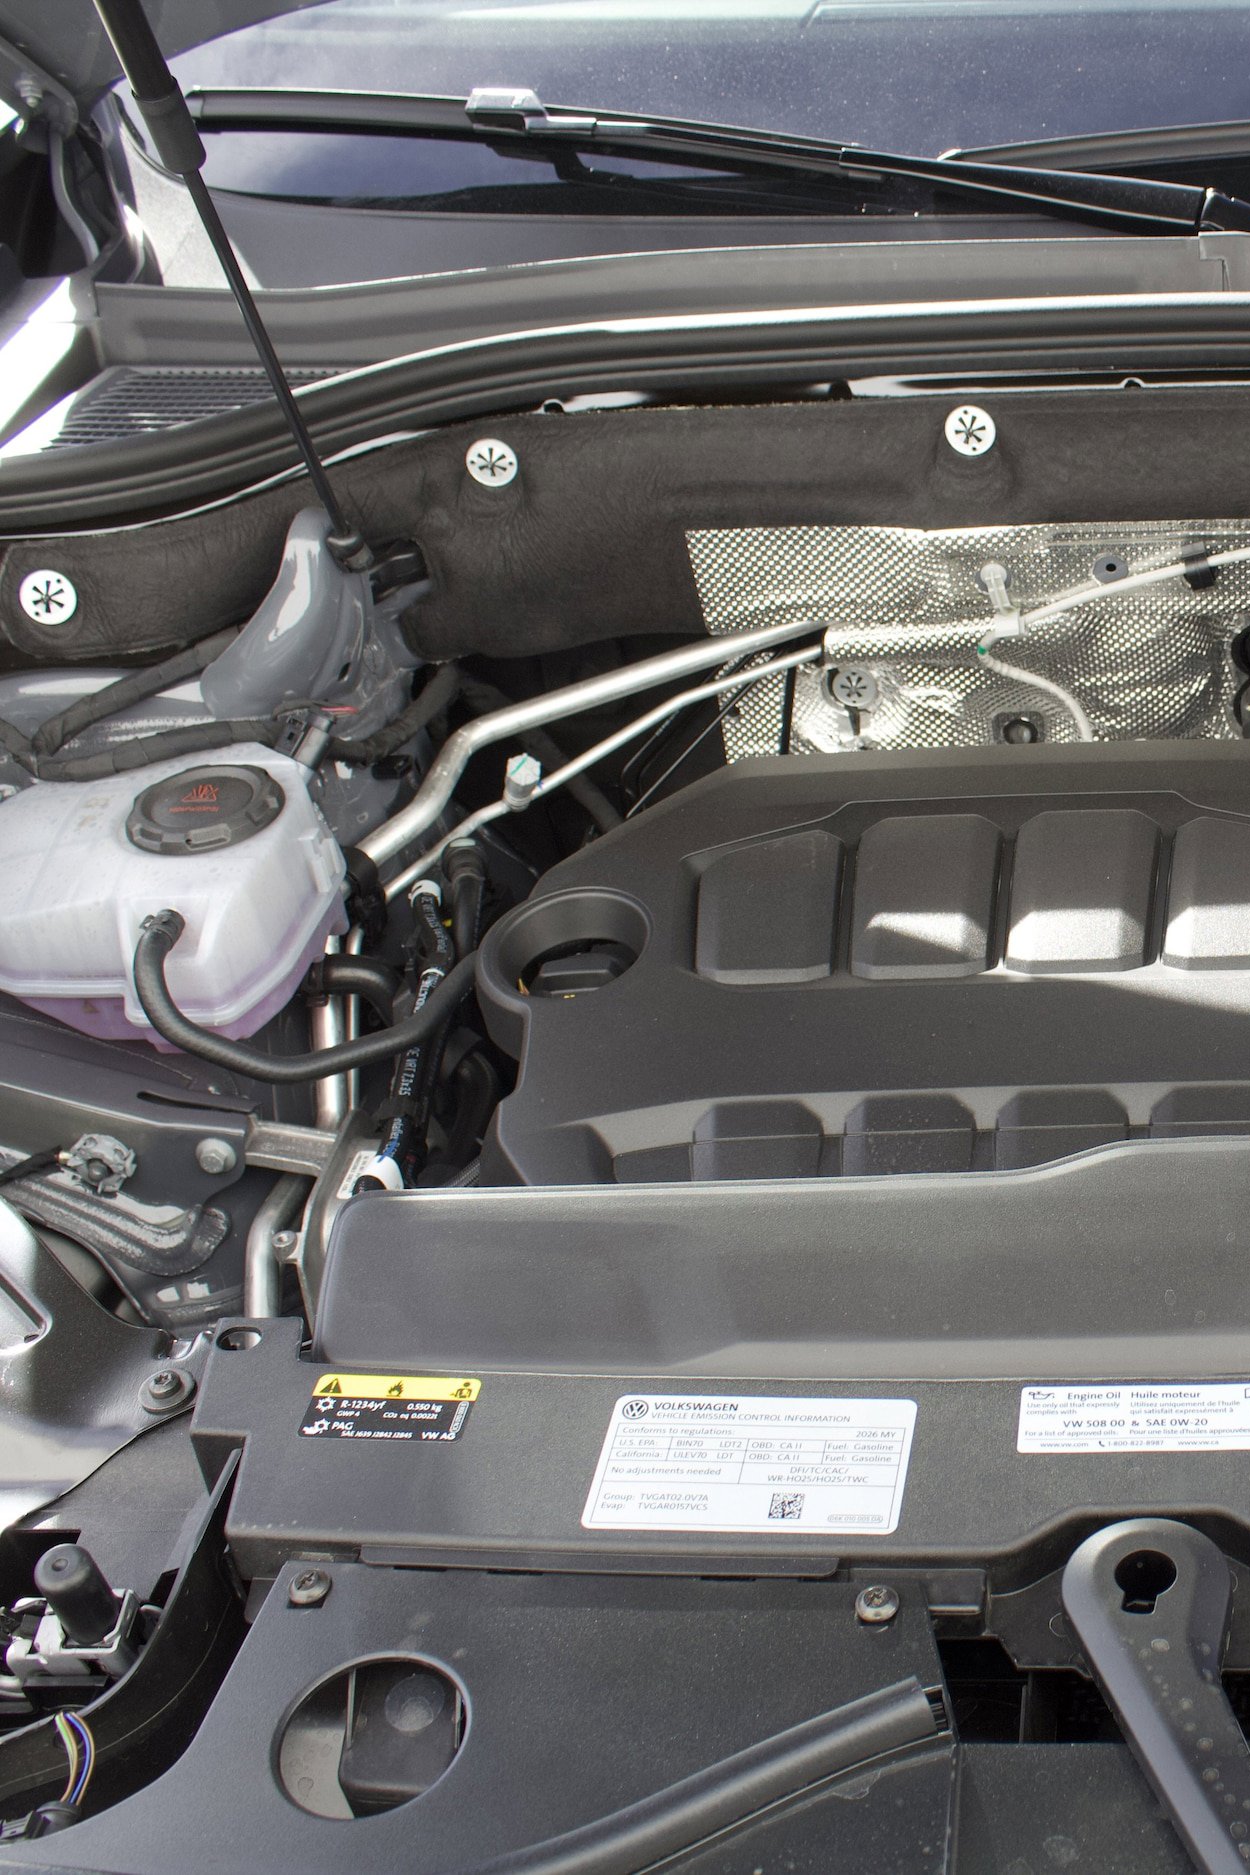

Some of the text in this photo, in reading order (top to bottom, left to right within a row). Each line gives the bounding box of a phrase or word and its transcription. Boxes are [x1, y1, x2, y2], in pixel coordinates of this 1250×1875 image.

[1067, 1391, 1121, 1401] Engine Oil
[1161, 1391, 1200, 1399] moteur
[341, 1400, 386, 1411] R-1234yf
[431, 1404, 443, 1412] kg
[654, 1402, 739, 1411] VOLKSWAGEN
[739, 1413, 781, 1422] CONTROL
[784, 1415, 850, 1423] INFORMATION
[332, 1422, 354, 1430] PAG
[622, 1426, 666, 1434] Conforms
[681, 1427, 734, 1436] regulations:
[676, 1439, 704, 1447] BIN70
[674, 1451, 707, 1459] ULEV70
[851, 1455, 892, 1463] Gasoline
[627, 1467, 684, 1476] adjustments
[687, 1468, 722, 1476] needed
[790, 1467, 849, 1475] DFI/TC/CAC/
[603, 1493, 634, 1501] Group:
[601, 1502, 625, 1510] Evap:
